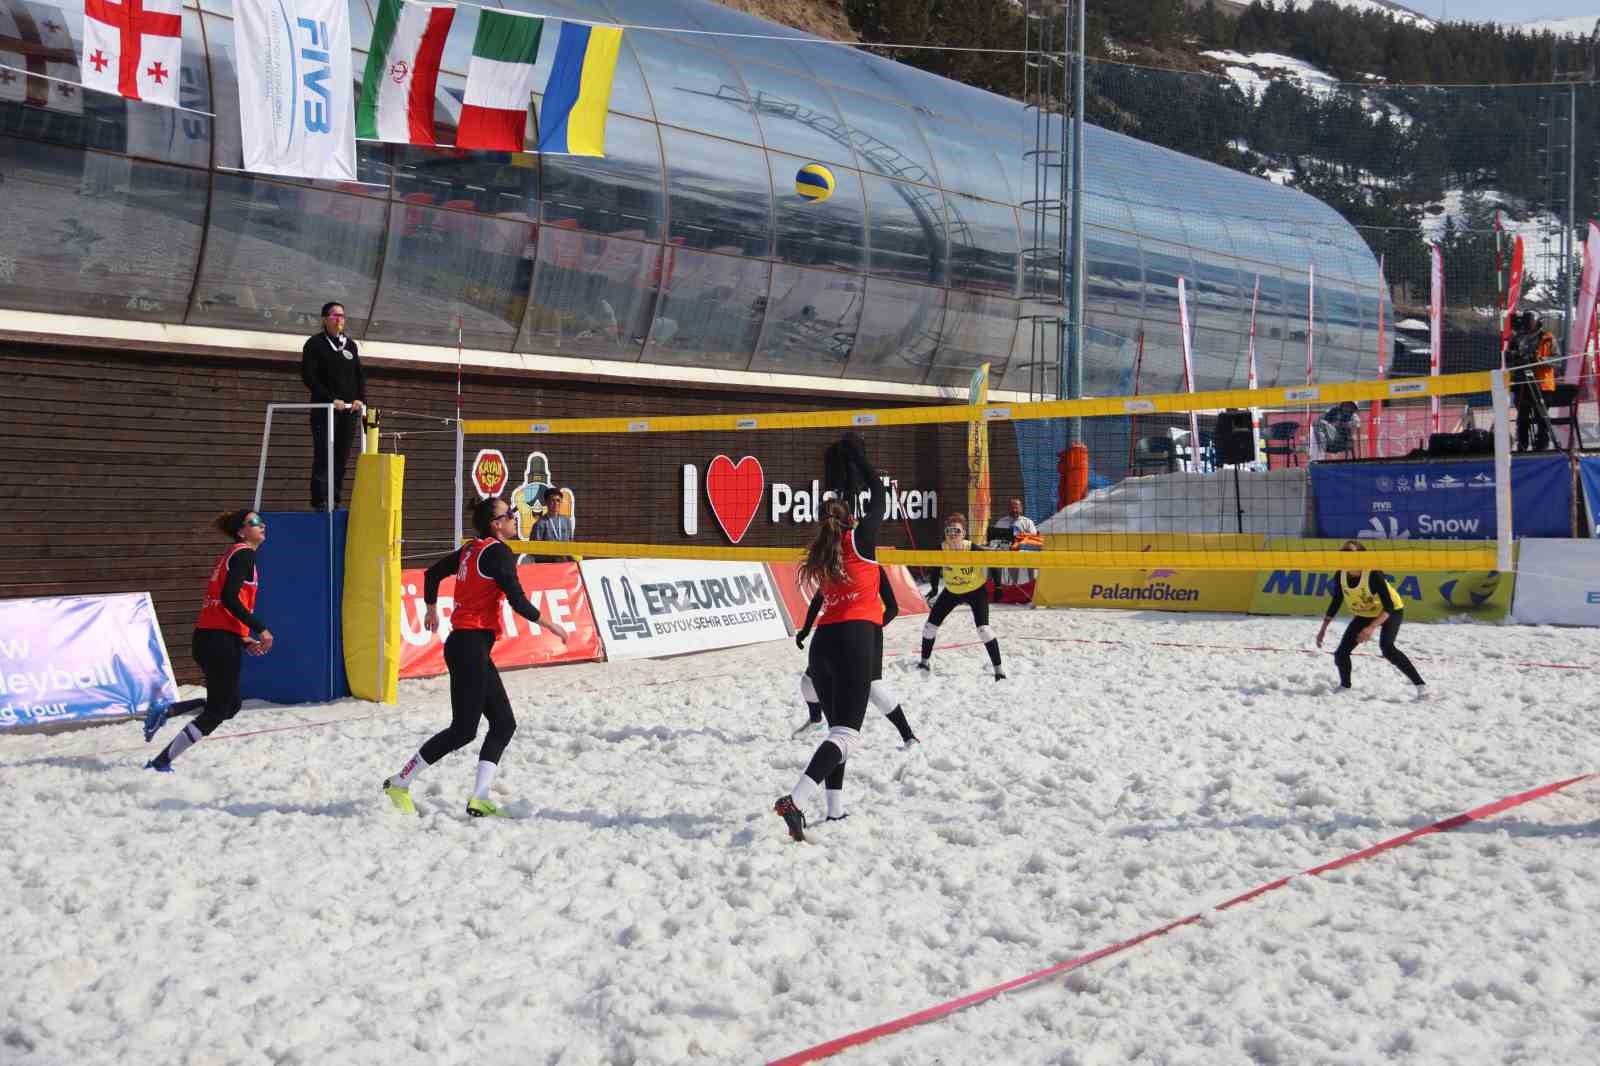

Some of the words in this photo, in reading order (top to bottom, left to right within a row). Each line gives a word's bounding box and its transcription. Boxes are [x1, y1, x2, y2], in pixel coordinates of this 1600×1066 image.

[297, 16, 333, 136] FIVB
[1418, 514, 1480, 534] Snow
[641, 573, 770, 615] ERZURUM
[1090, 582, 1200, 602] Palandöken
[24, 701, 68, 718] Tour
